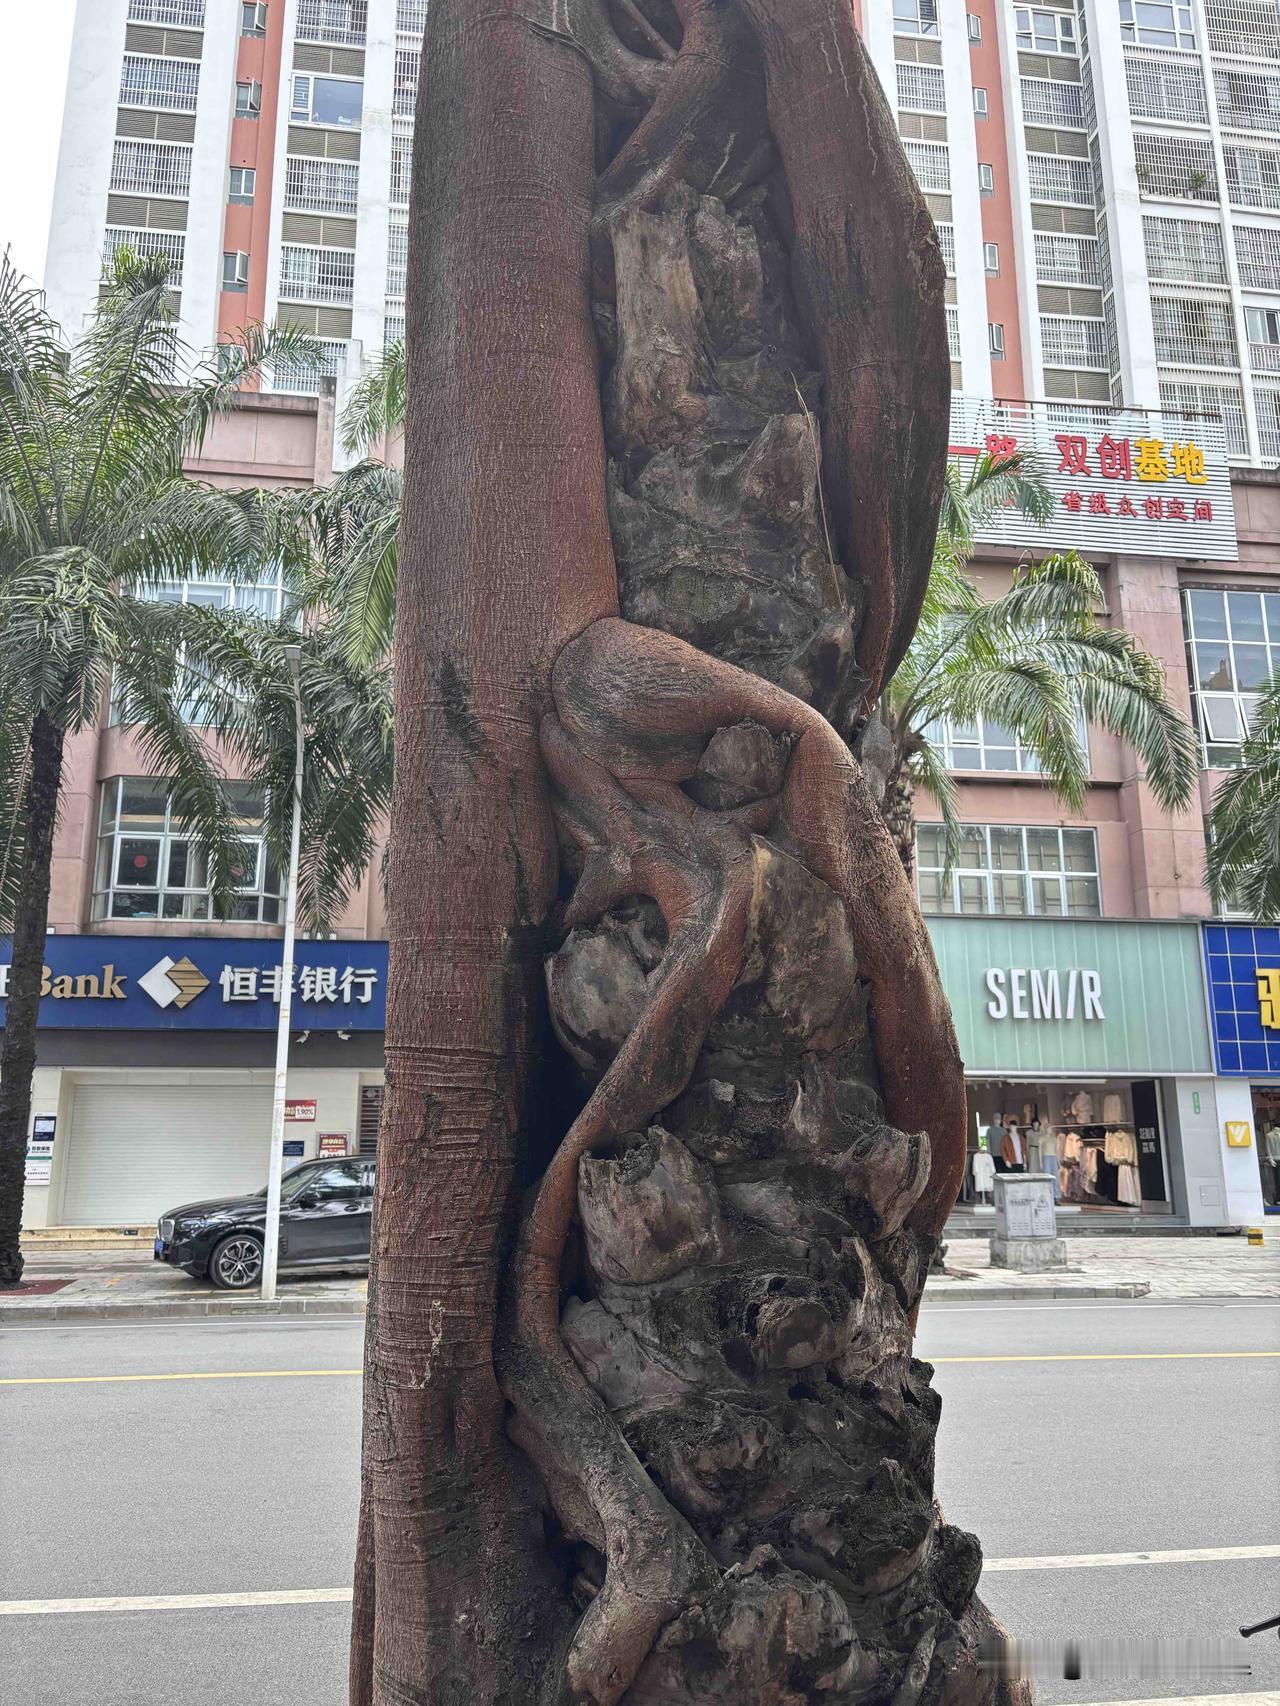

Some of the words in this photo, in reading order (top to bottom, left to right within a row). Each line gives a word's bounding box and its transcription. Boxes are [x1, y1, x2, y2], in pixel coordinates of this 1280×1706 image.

[1055, 433, 1208, 485] 双创基地
[1062, 489, 1213, 522] 省级众创空间
[218, 964, 378, 1003] 恒丰银行
[985, 967, 1106, 1020] SEMIR
